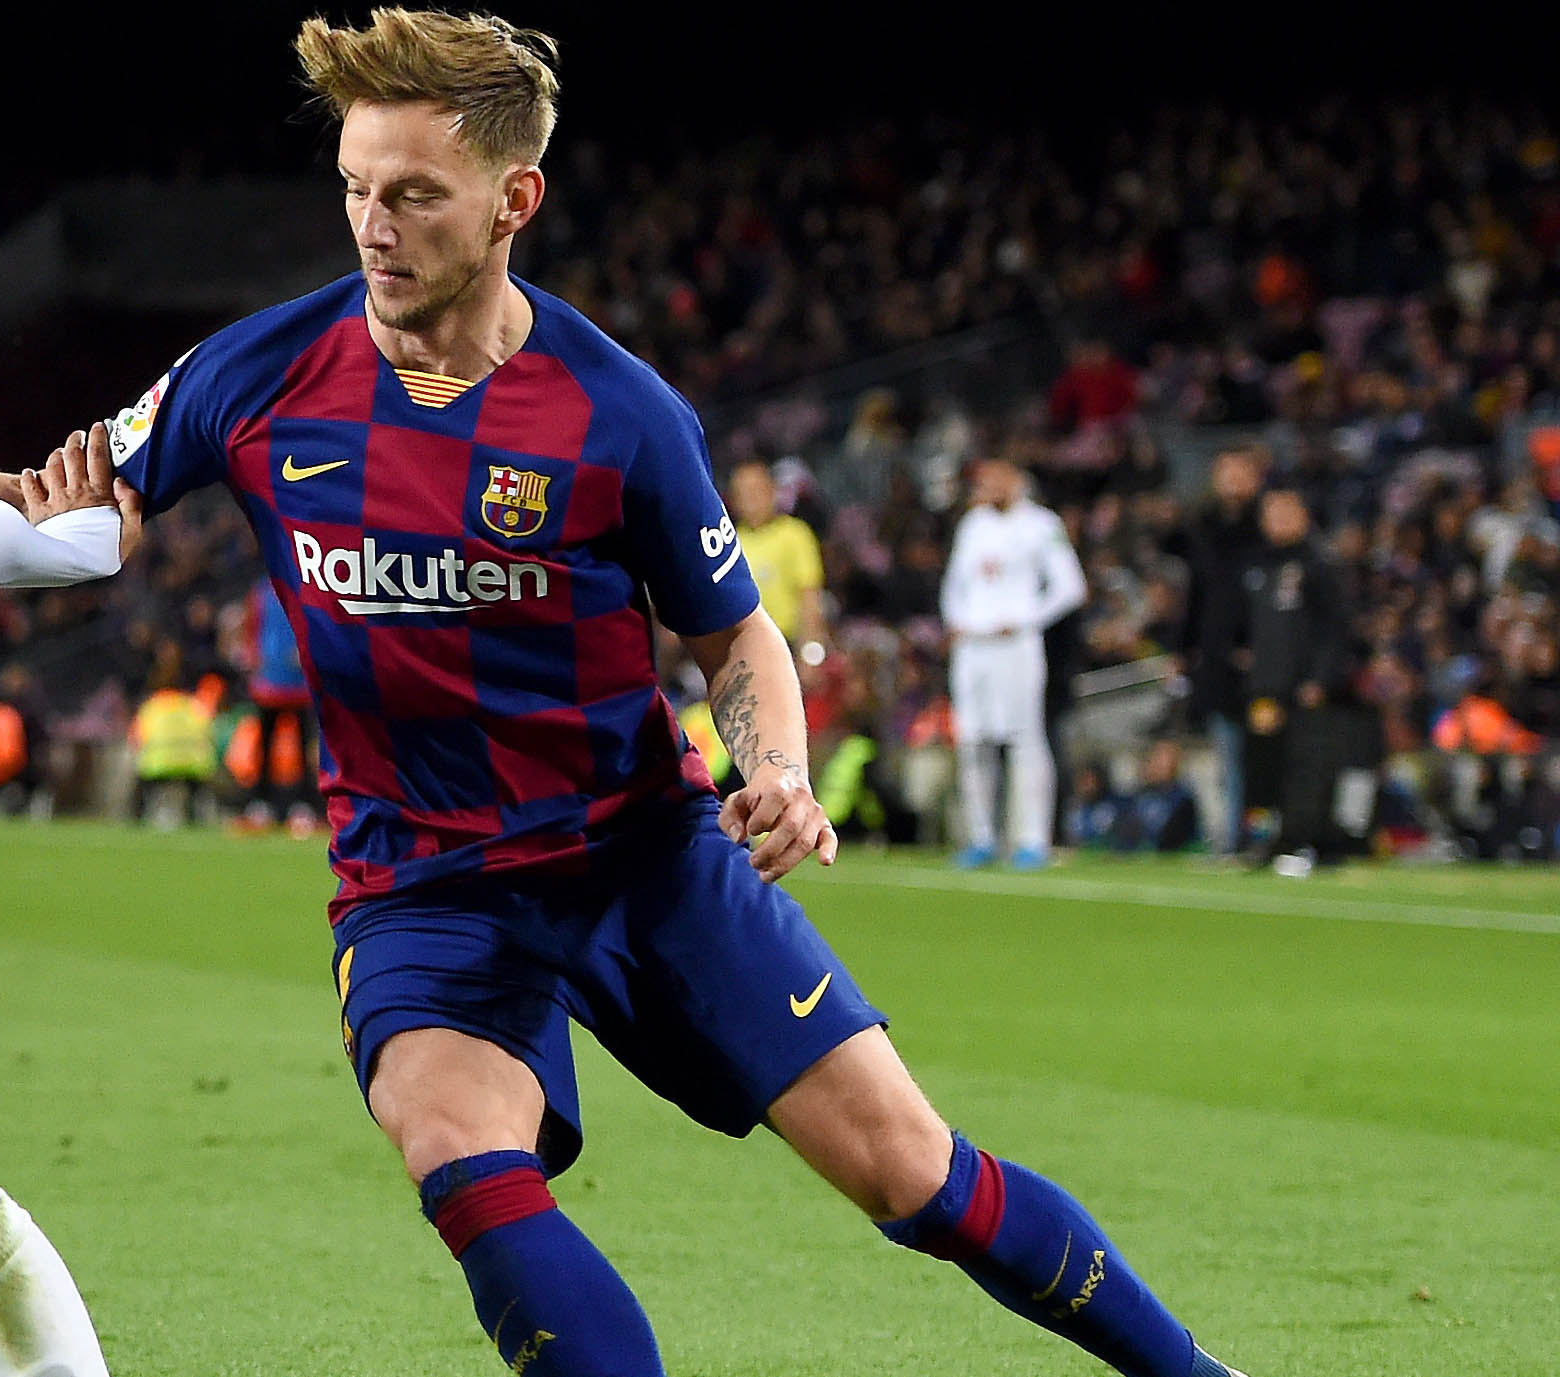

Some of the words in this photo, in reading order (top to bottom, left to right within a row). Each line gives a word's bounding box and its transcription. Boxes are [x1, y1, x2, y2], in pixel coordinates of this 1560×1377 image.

[501, 495, 527, 507] FCB
[700, 504, 737, 558] be
[293, 529, 548, 602] Rakuten
[1050, 1250, 1105, 1318] ARÇA
